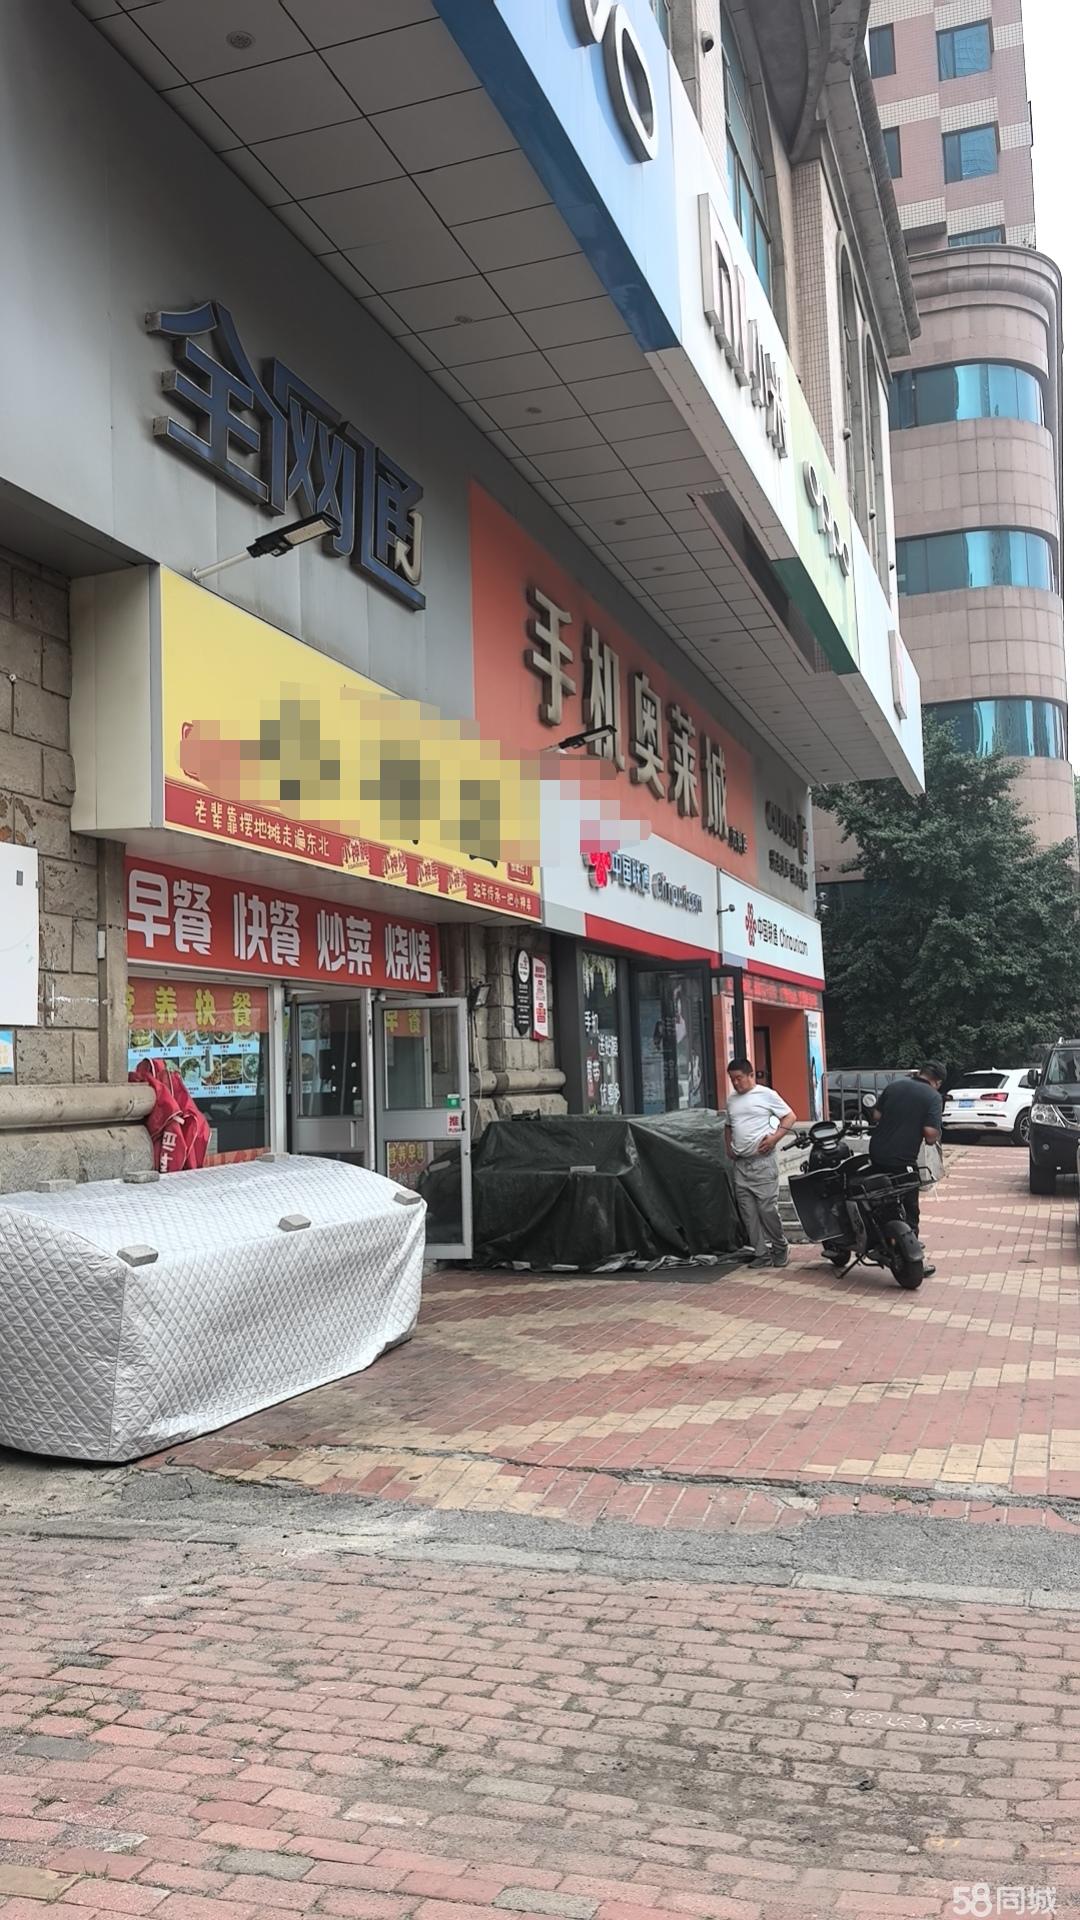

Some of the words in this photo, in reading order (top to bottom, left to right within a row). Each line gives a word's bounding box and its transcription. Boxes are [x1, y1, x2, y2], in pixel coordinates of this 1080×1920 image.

[525, 584, 730, 842] 手机奥莱城
[194, 797, 330, 858] 老辈靠摆地摊走遍东北
[611, 849, 651, 897] 中国联通
[127, 868, 213, 956] 早餐
[233, 890, 302, 969] 快餐
[317, 908, 374, 978] 炒菜
[384, 922, 432, 984] 烧烤
[757, 916, 779, 946] 中国联通
[448, 1115, 460, 1127] 推
